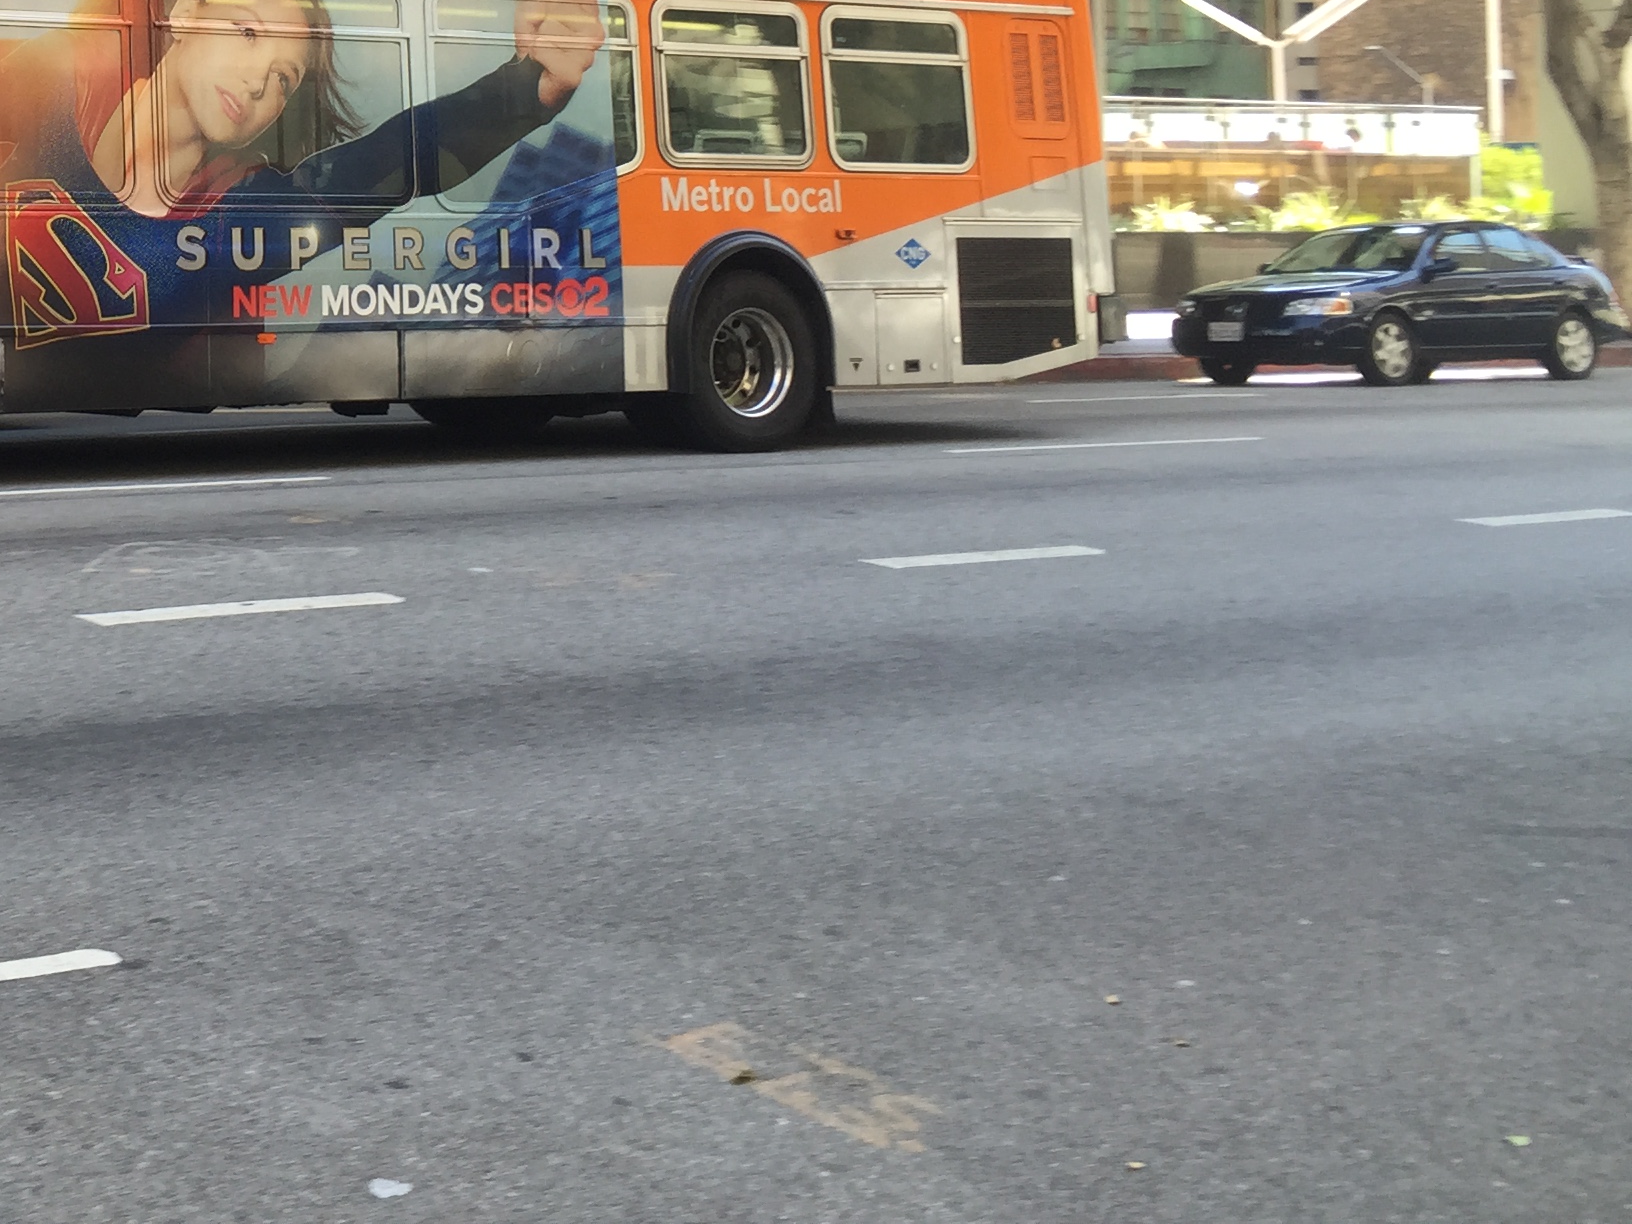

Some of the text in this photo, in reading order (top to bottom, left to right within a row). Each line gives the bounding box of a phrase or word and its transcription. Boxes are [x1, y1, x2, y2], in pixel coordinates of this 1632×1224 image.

[660, 176, 843, 213] Metro Local
[175, 225, 607, 271] SUPERGIRL
[232, 284, 312, 318] NEW
[321, 282, 484, 317] MONDAYS
